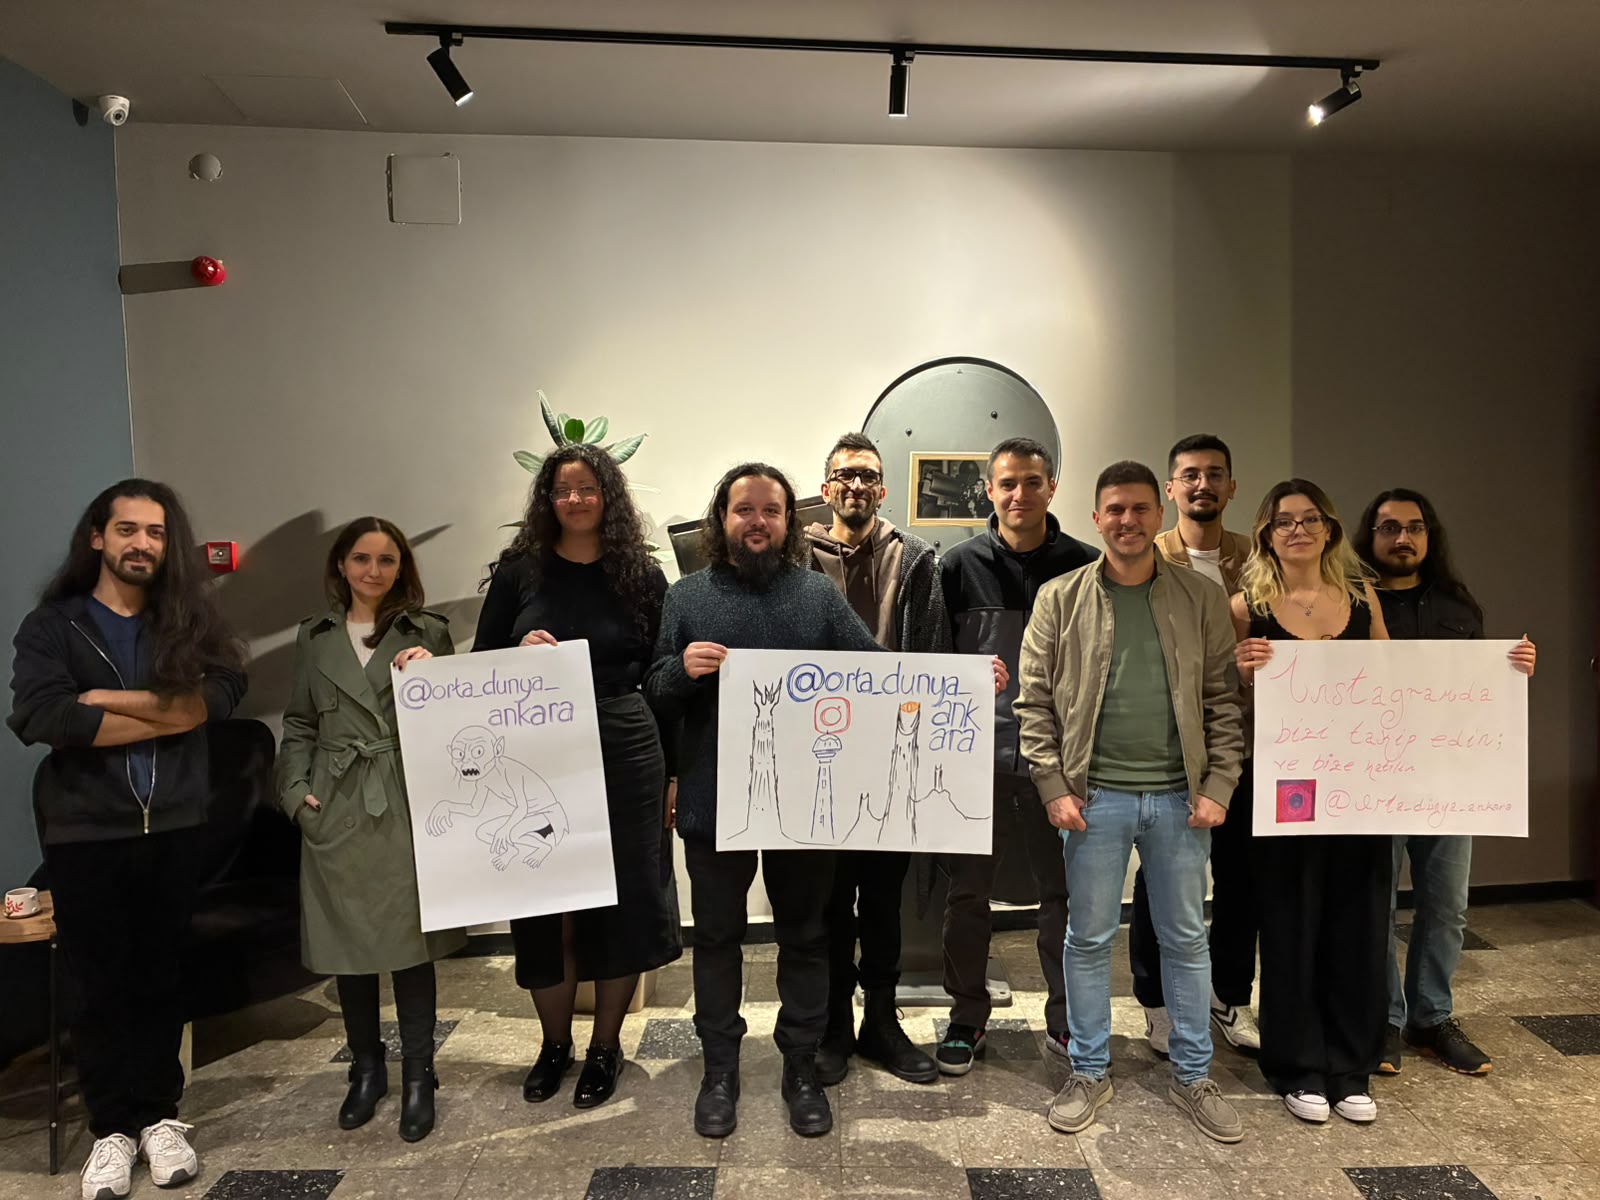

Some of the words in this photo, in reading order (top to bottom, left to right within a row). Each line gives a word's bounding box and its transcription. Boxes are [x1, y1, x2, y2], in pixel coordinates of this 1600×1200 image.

[400, 668, 560, 709] @orta_dunya_
[786, 661, 972, 706] @orta_dunya_
[488, 700, 574, 727] ankara
[931, 699, 982, 731] ank
[929, 728, 975, 753] ara
[1274, 716, 1335, 744] bizi
[1274, 759, 1299, 771] ve
[1313, 753, 1354, 772] bize
